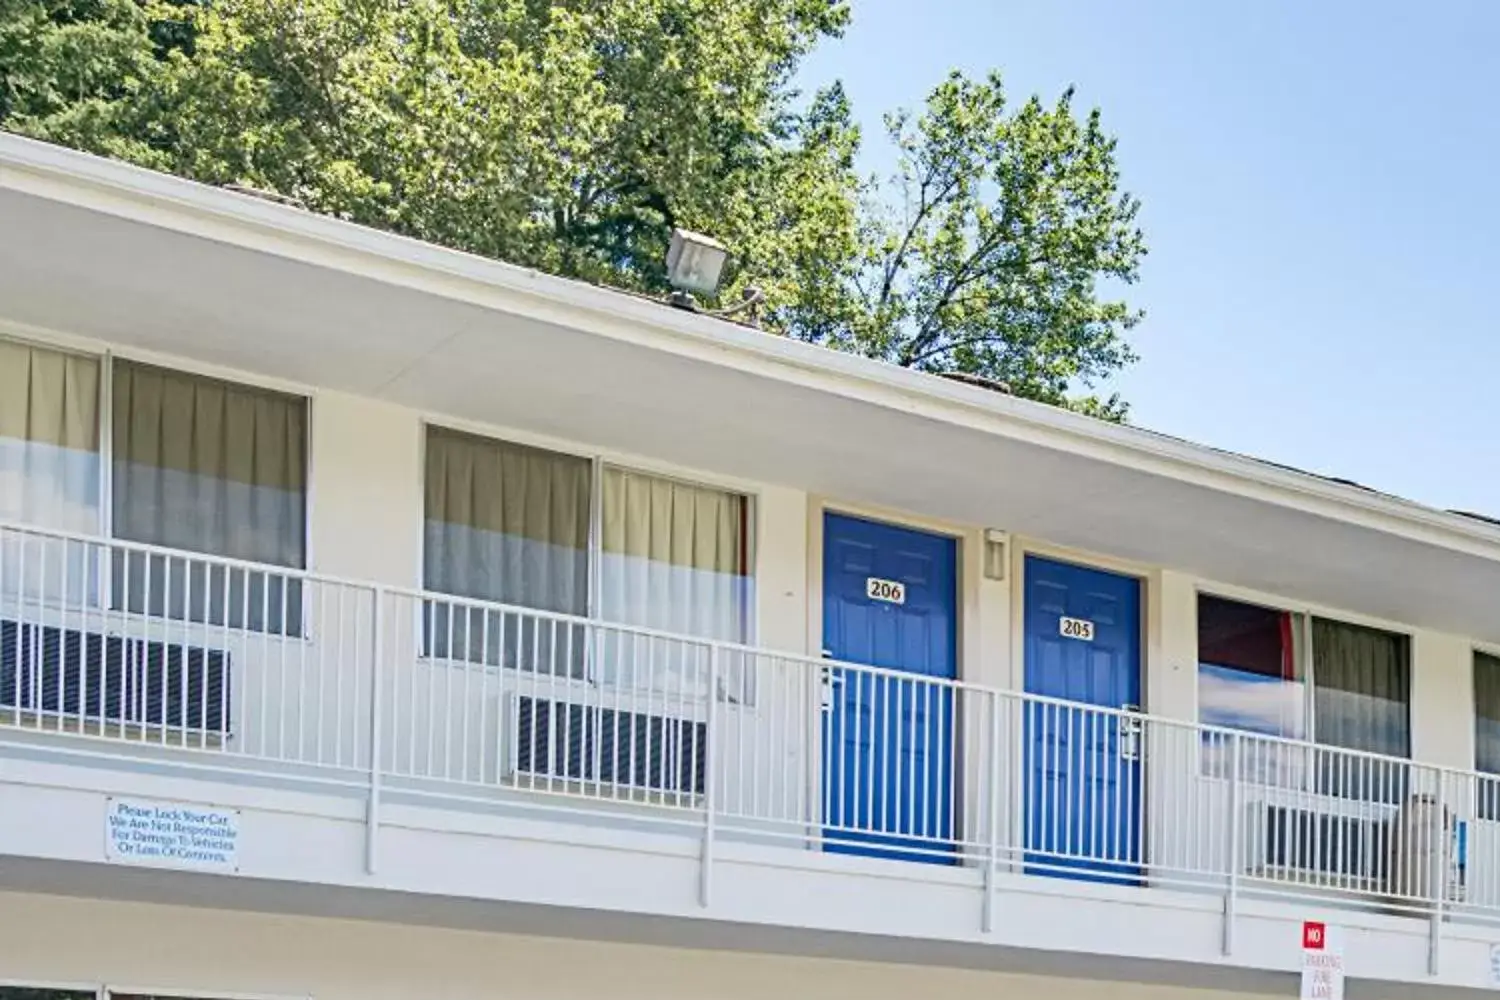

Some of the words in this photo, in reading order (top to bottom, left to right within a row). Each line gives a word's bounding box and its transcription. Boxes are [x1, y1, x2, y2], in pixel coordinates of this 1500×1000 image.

[871, 581, 901, 600] 206
[1064, 619, 1090, 638] 205
[118, 803, 152, 817] Please
[155, 807, 181, 820] Lock
[181, 810, 206, 823] Your
[109, 815, 126, 826] We
[130, 818, 149, 829] Are
[151, 819, 172, 832] Not
[174, 823, 237, 838] Responsible
[111, 828, 130, 840] For
[132, 830, 176, 845] Damage
[191, 835, 235, 851] Vehicles
[118, 841, 134, 854] Or
[1307, 927, 1321, 943] NO
